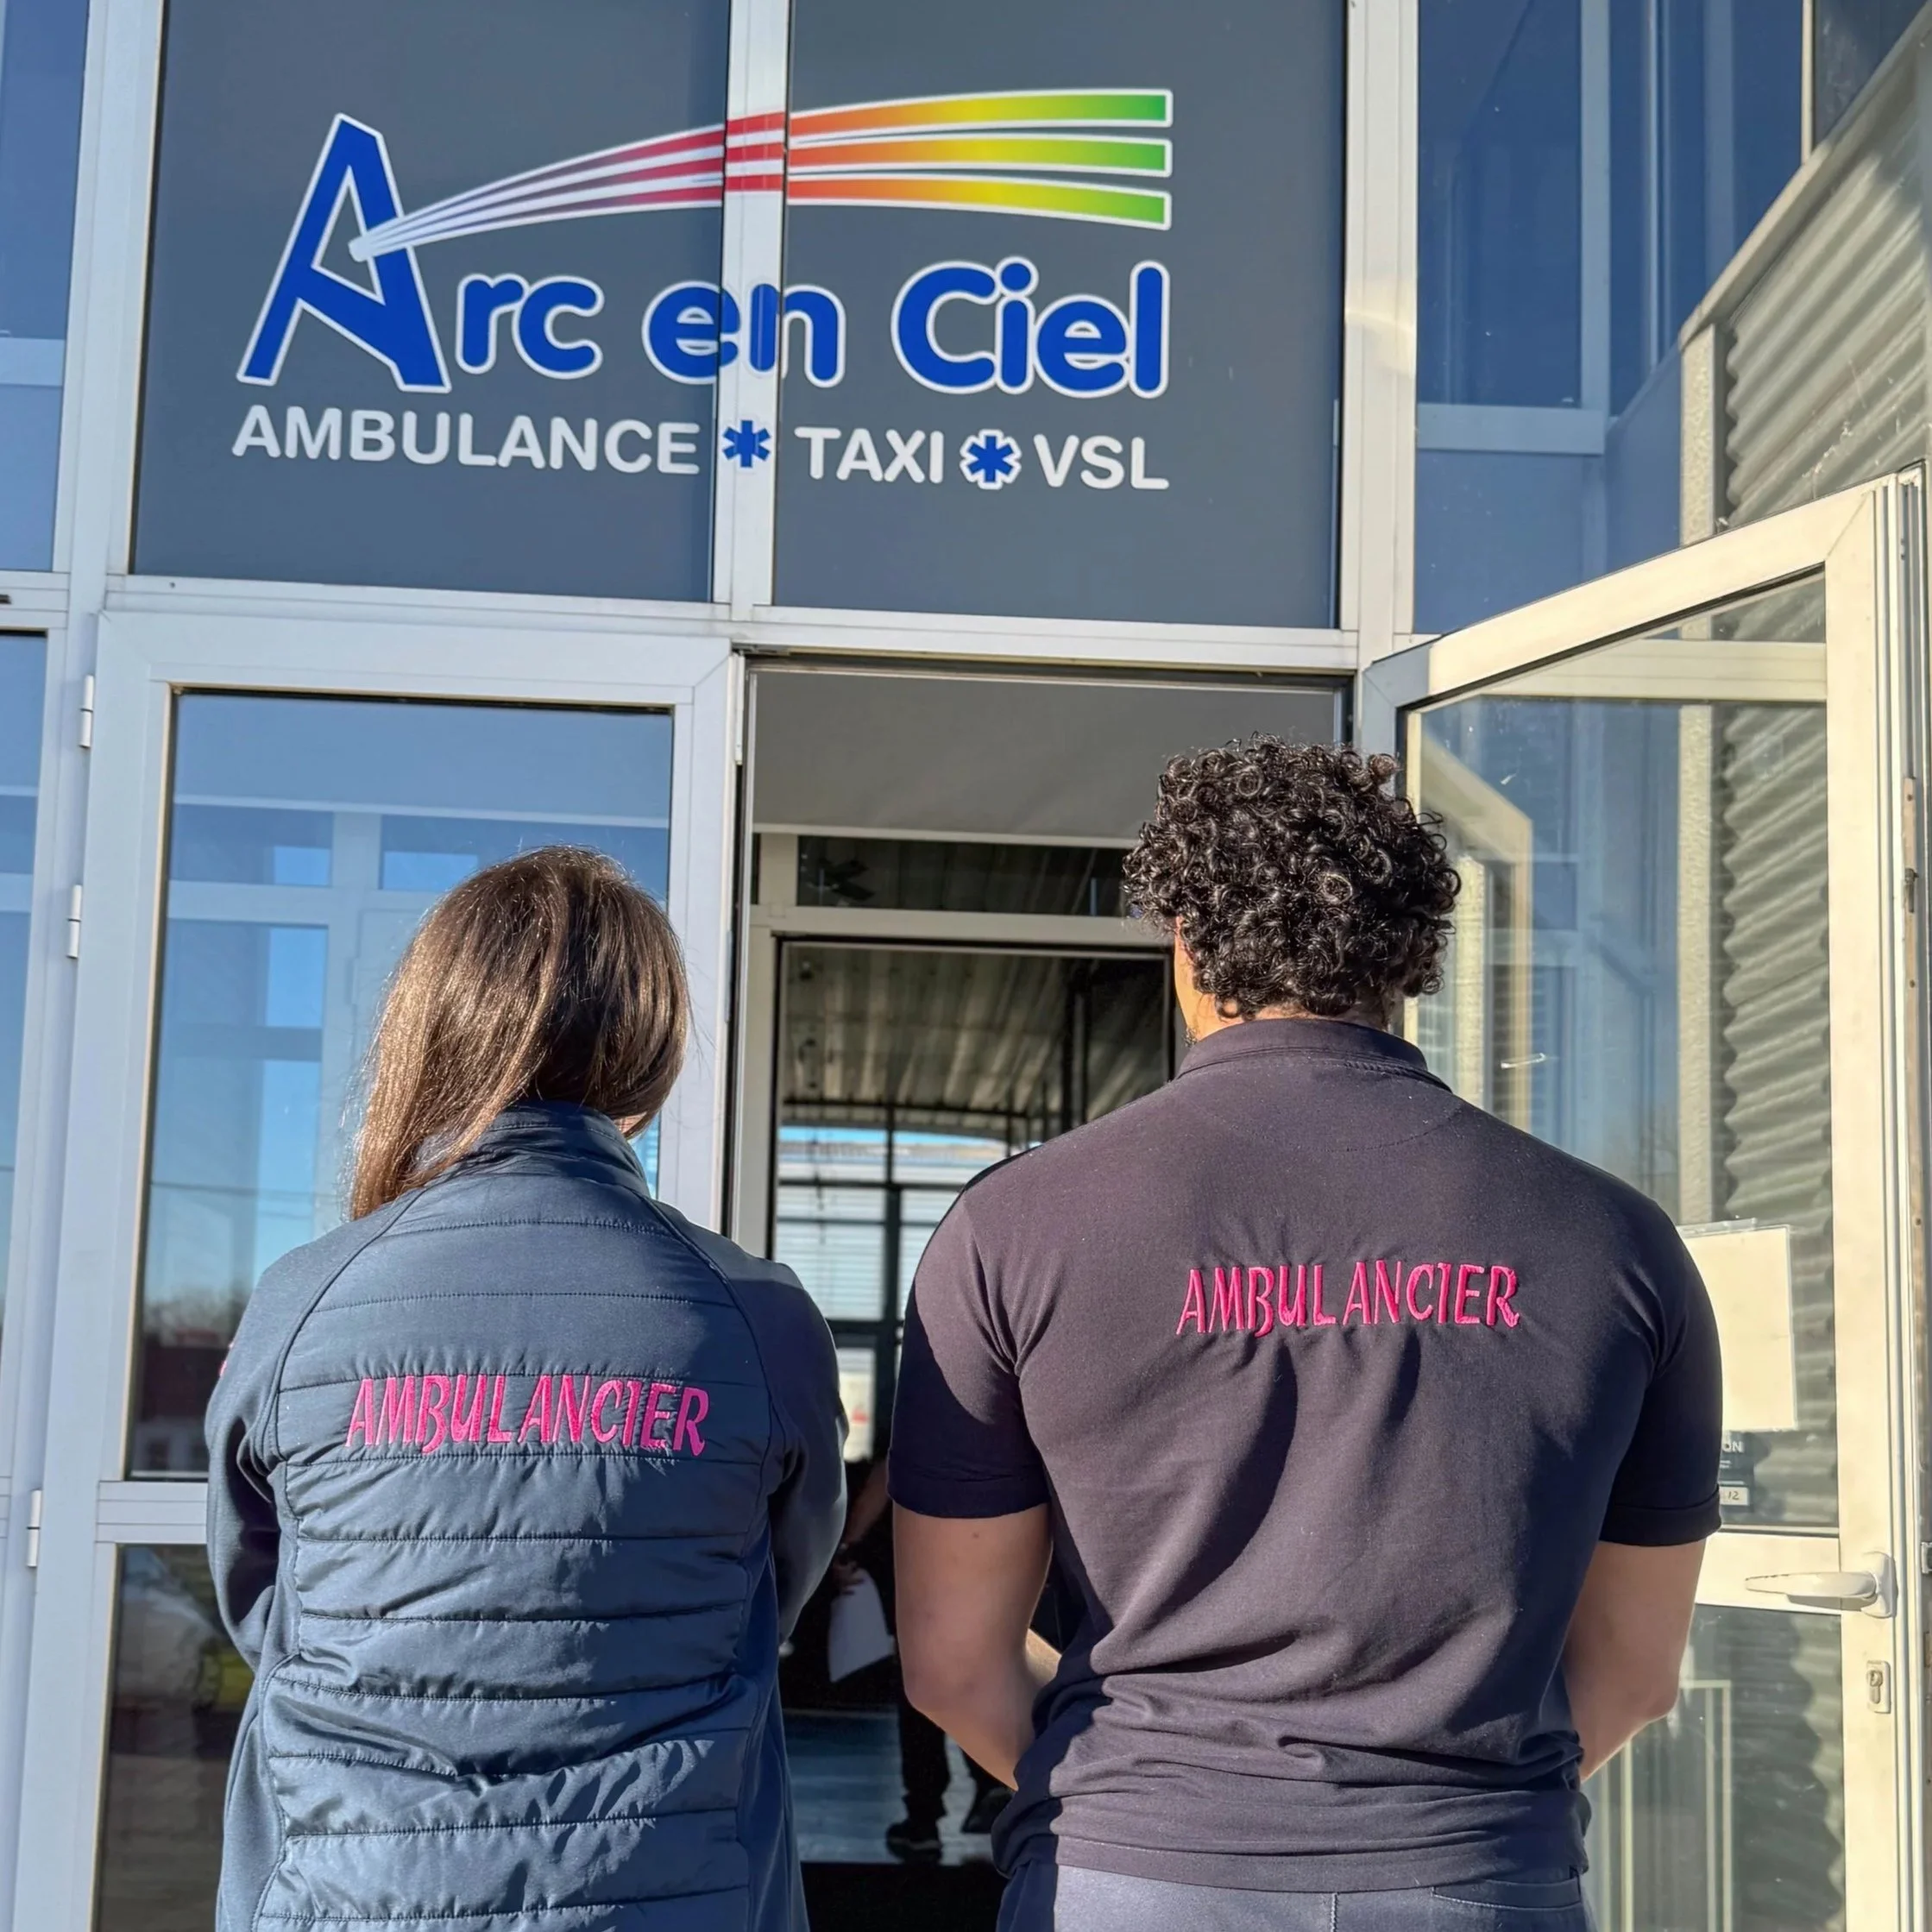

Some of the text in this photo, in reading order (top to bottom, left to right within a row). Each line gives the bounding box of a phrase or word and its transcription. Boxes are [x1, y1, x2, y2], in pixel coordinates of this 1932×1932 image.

[236, 112, 1170, 400] Arc en Ciel
[232, 404, 1169, 490] AMBULANCE TAXI VSL
[1176, 1260, 1520, 1337] AMBULANCIER
[345, 1375, 709, 1456] AMBULANCIER
